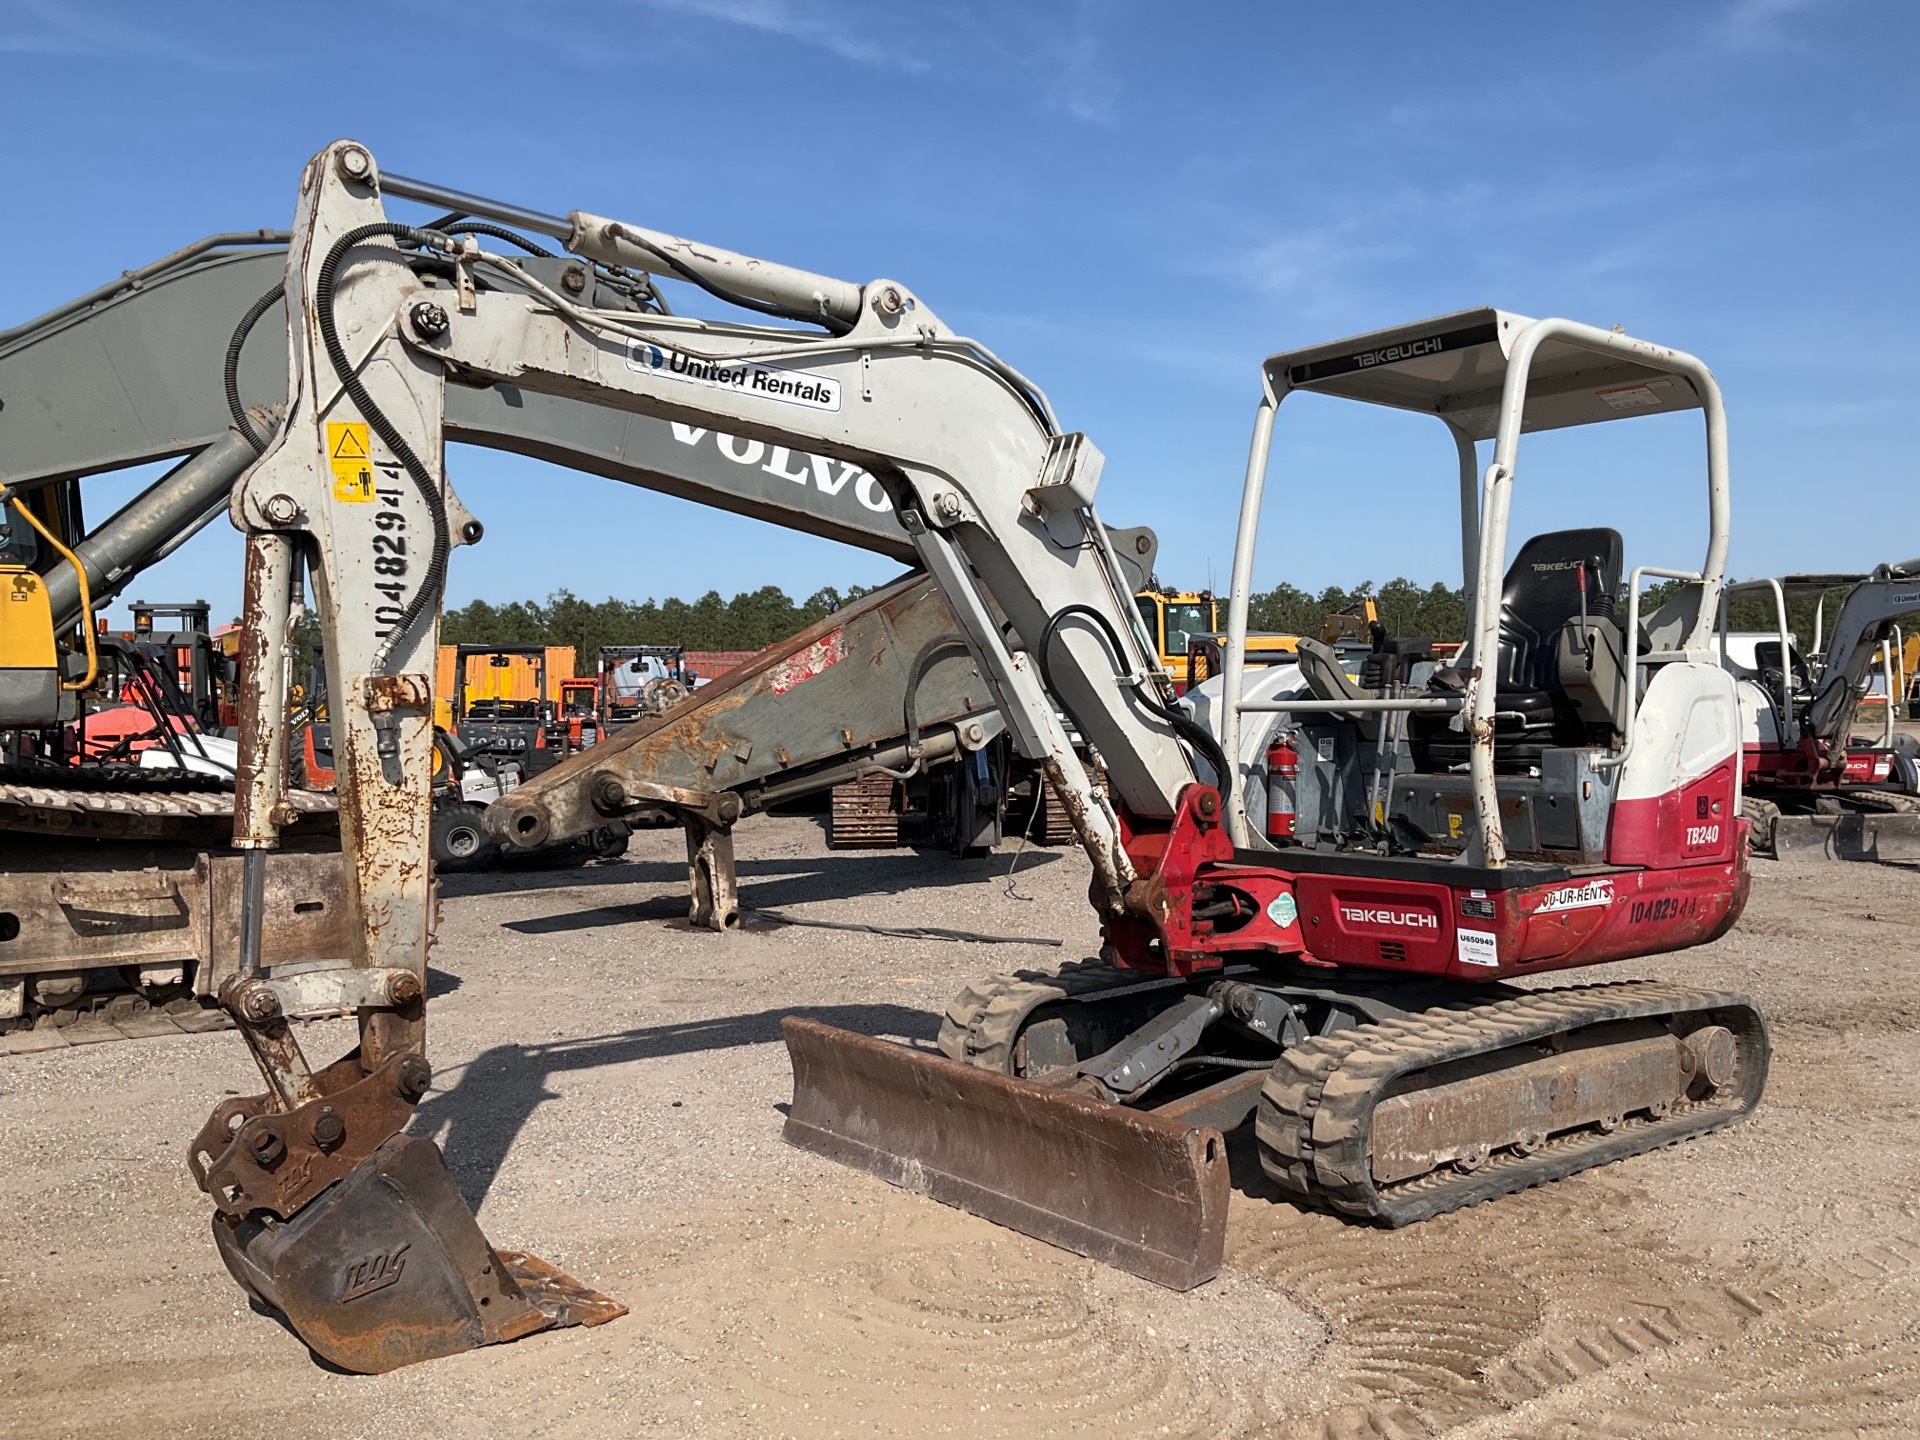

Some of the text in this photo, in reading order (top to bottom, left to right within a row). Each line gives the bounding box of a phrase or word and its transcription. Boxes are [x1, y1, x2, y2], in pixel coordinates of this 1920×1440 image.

[1353, 338, 1442, 367] TAKEUCHI
[669, 352, 831, 403] United Rentals
[469, 737, 526, 747] TOOTA
[1687, 825, 1719, 845] TB240
[1341, 908, 1438, 928] TAKEUCHI
[1630, 896, 1697, 924] 10482944
[1460, 935, 1494, 946] U650949
